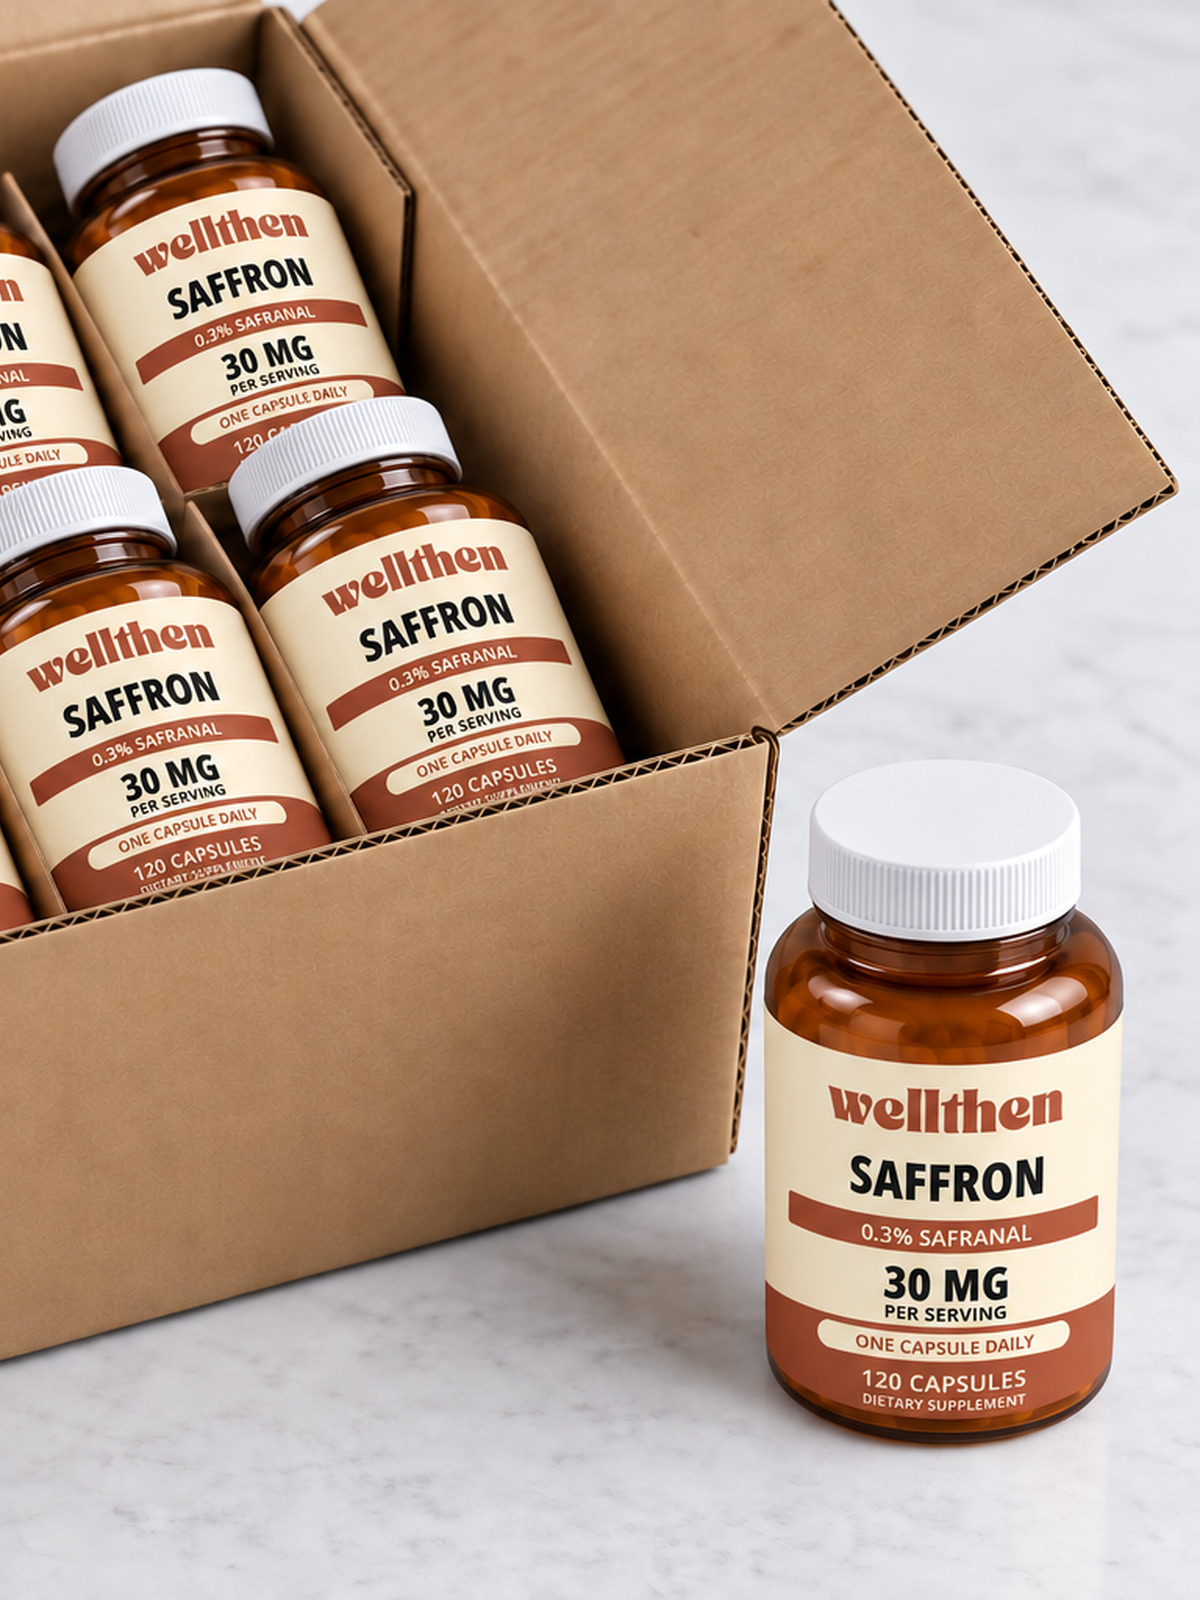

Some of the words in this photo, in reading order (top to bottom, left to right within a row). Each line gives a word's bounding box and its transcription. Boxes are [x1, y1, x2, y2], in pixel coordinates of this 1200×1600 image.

[133, 209, 309, 276] wellthen
[168, 258, 313, 320] SAFFRON
[194, 323, 233, 347] 0.3%
[235, 306, 316, 331] SAFRANAL
[221, 348, 258, 380] 30
[263, 335, 314, 367] MG
[230, 381, 258, 395] PER
[260, 364, 320, 387] SERVING
[220, 411, 249, 429] ONE
[253, 391, 312, 417] CAPSULE
[313, 386, 348, 401] DAILY
[26, 449, 61, 463] DAILY
[234, 433, 263, 455] 120
[321, 543, 508, 616] wellthen
[360, 594, 514, 662] SAFFRON
[26, 621, 215, 692] wellthen
[389, 666, 429, 691] 0.3%
[432, 645, 517, 675] SAFRANAL
[63, 671, 220, 738] SAFFRON
[418, 691, 457, 726] 30
[462, 677, 515, 712] MG
[92, 743, 133, 767] 0.3%
[135, 722, 222, 750] SAFRANAL
[427, 727, 456, 743] PER
[459, 707, 522, 732] SERVING
[416, 757, 449, 778] ONE
[452, 737, 513, 766] CAPSULE
[516, 730, 552, 747] DAILY
[120, 768, 160, 801] 30
[165, 755, 220, 788] MG
[130, 801, 160, 817] PER
[163, 784, 225, 808] SERVING
[432, 783, 464, 805] 120
[468, 759, 557, 792] CAPSULES
[118, 836, 151, 853] ONE
[154, 815, 217, 841] CAPSULE
[219, 808, 257, 824] DAILY
[134, 860, 166, 881] 120
[171, 836, 262, 868] CAPSULES
[828, 1085, 1063, 1134] wellthen
[850, 1155, 1044, 1202] SAFFRON
[861, 1223, 913, 1245] 0.3%
[920, 1224, 1032, 1247] SAFRANAL
[884, 1265, 930, 1300] 30
[944, 1266, 1008, 1302] MG
[885, 1306, 918, 1321] PER
[925, 1306, 1007, 1322] SERVING
[856, 1334, 894, 1352] ONE
[900, 1339, 980, 1355] CAPSULE
[986, 1334, 1034, 1352] DAILY
[862, 1369, 901, 1389] 120
[909, 1370, 1026, 1393] CAPSULES
[863, 1393, 924, 1411] DIETARY
[927, 1394, 1026, 1411] SUPPLEMENT
